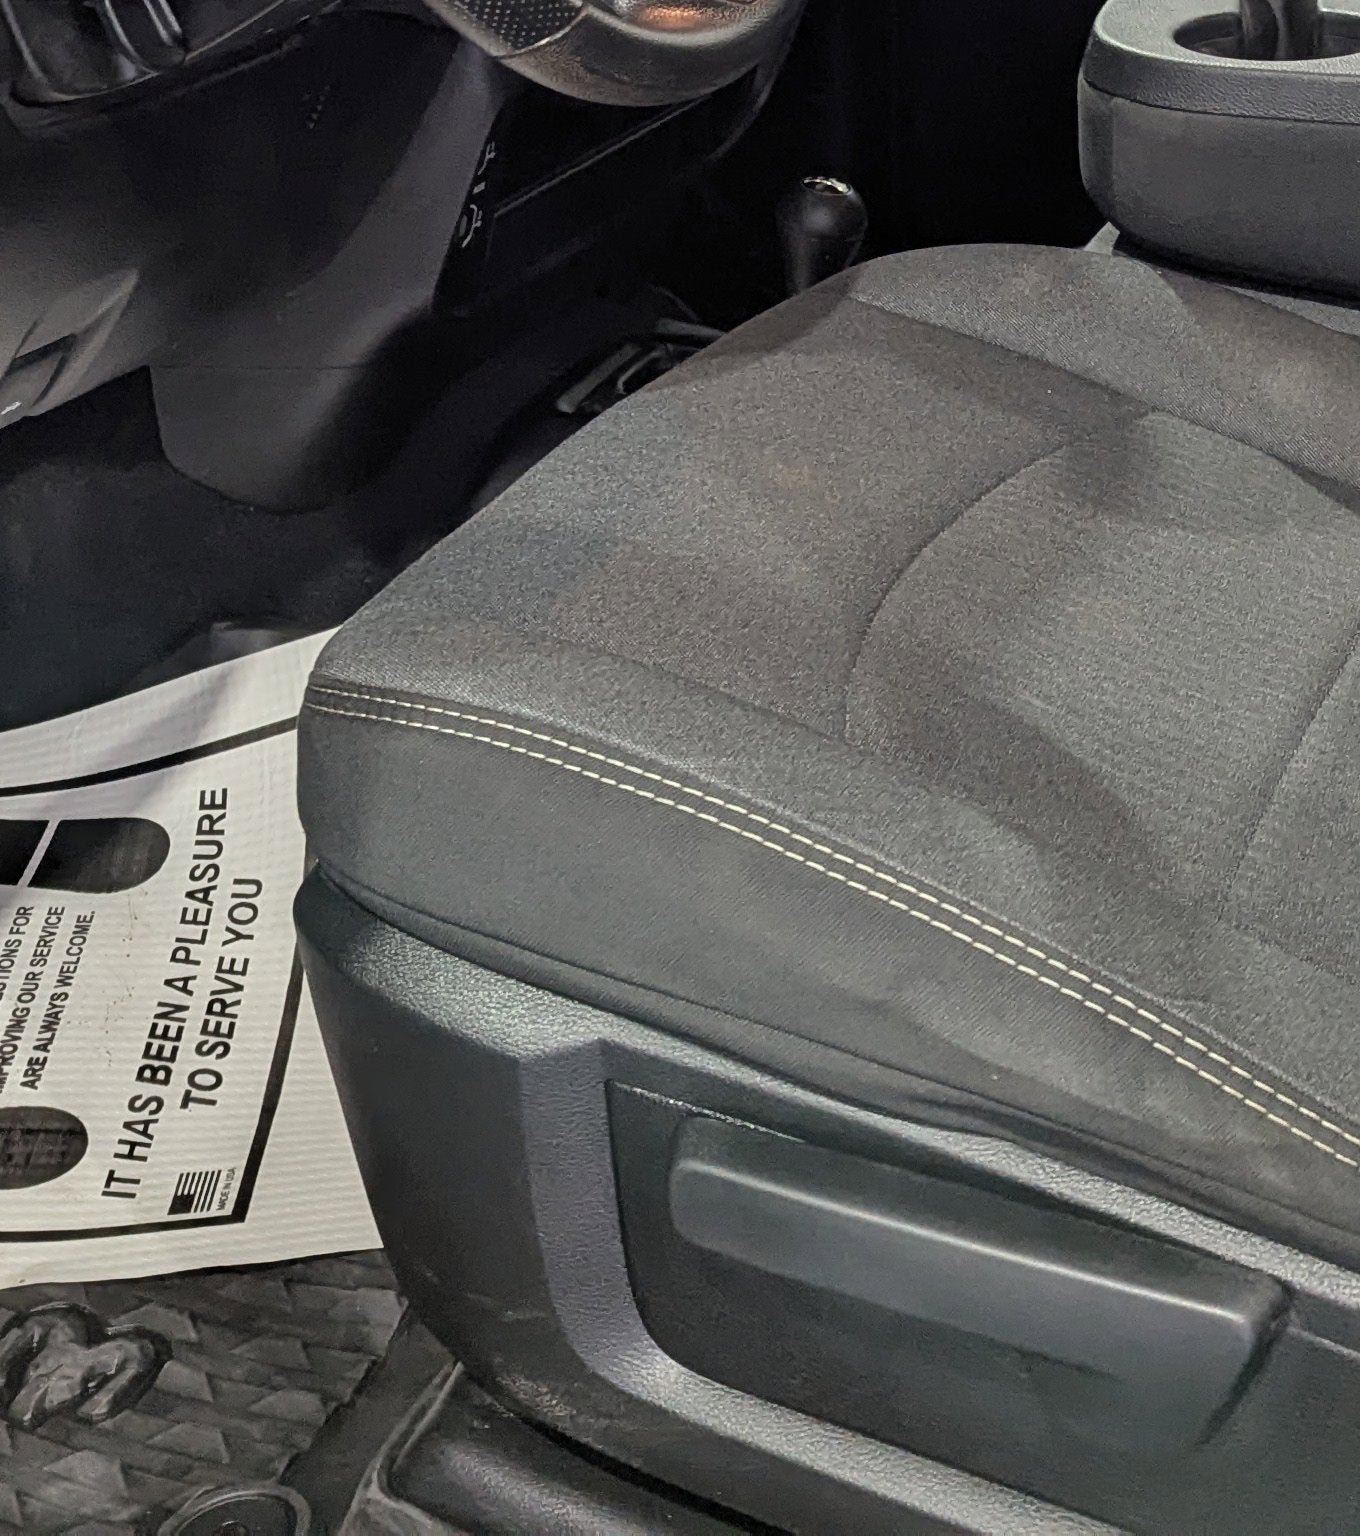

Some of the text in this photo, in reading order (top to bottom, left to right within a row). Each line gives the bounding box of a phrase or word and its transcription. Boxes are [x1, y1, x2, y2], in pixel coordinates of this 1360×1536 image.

[8, 905, 35, 935] FOR
[29, 905, 66, 969] SERVICE
[16, 970, 44, 1004] OUR
[19, 910, 96, 1090] ARE ALWAYS WELCOME.
[100, 787, 229, 1199] IT HAS BEEN A PLEASURE
[179, 877, 264, 1110] TO SERVE YOU
[222, 1182, 232, 1190] IN
[224, 1167, 237, 1182] USA
